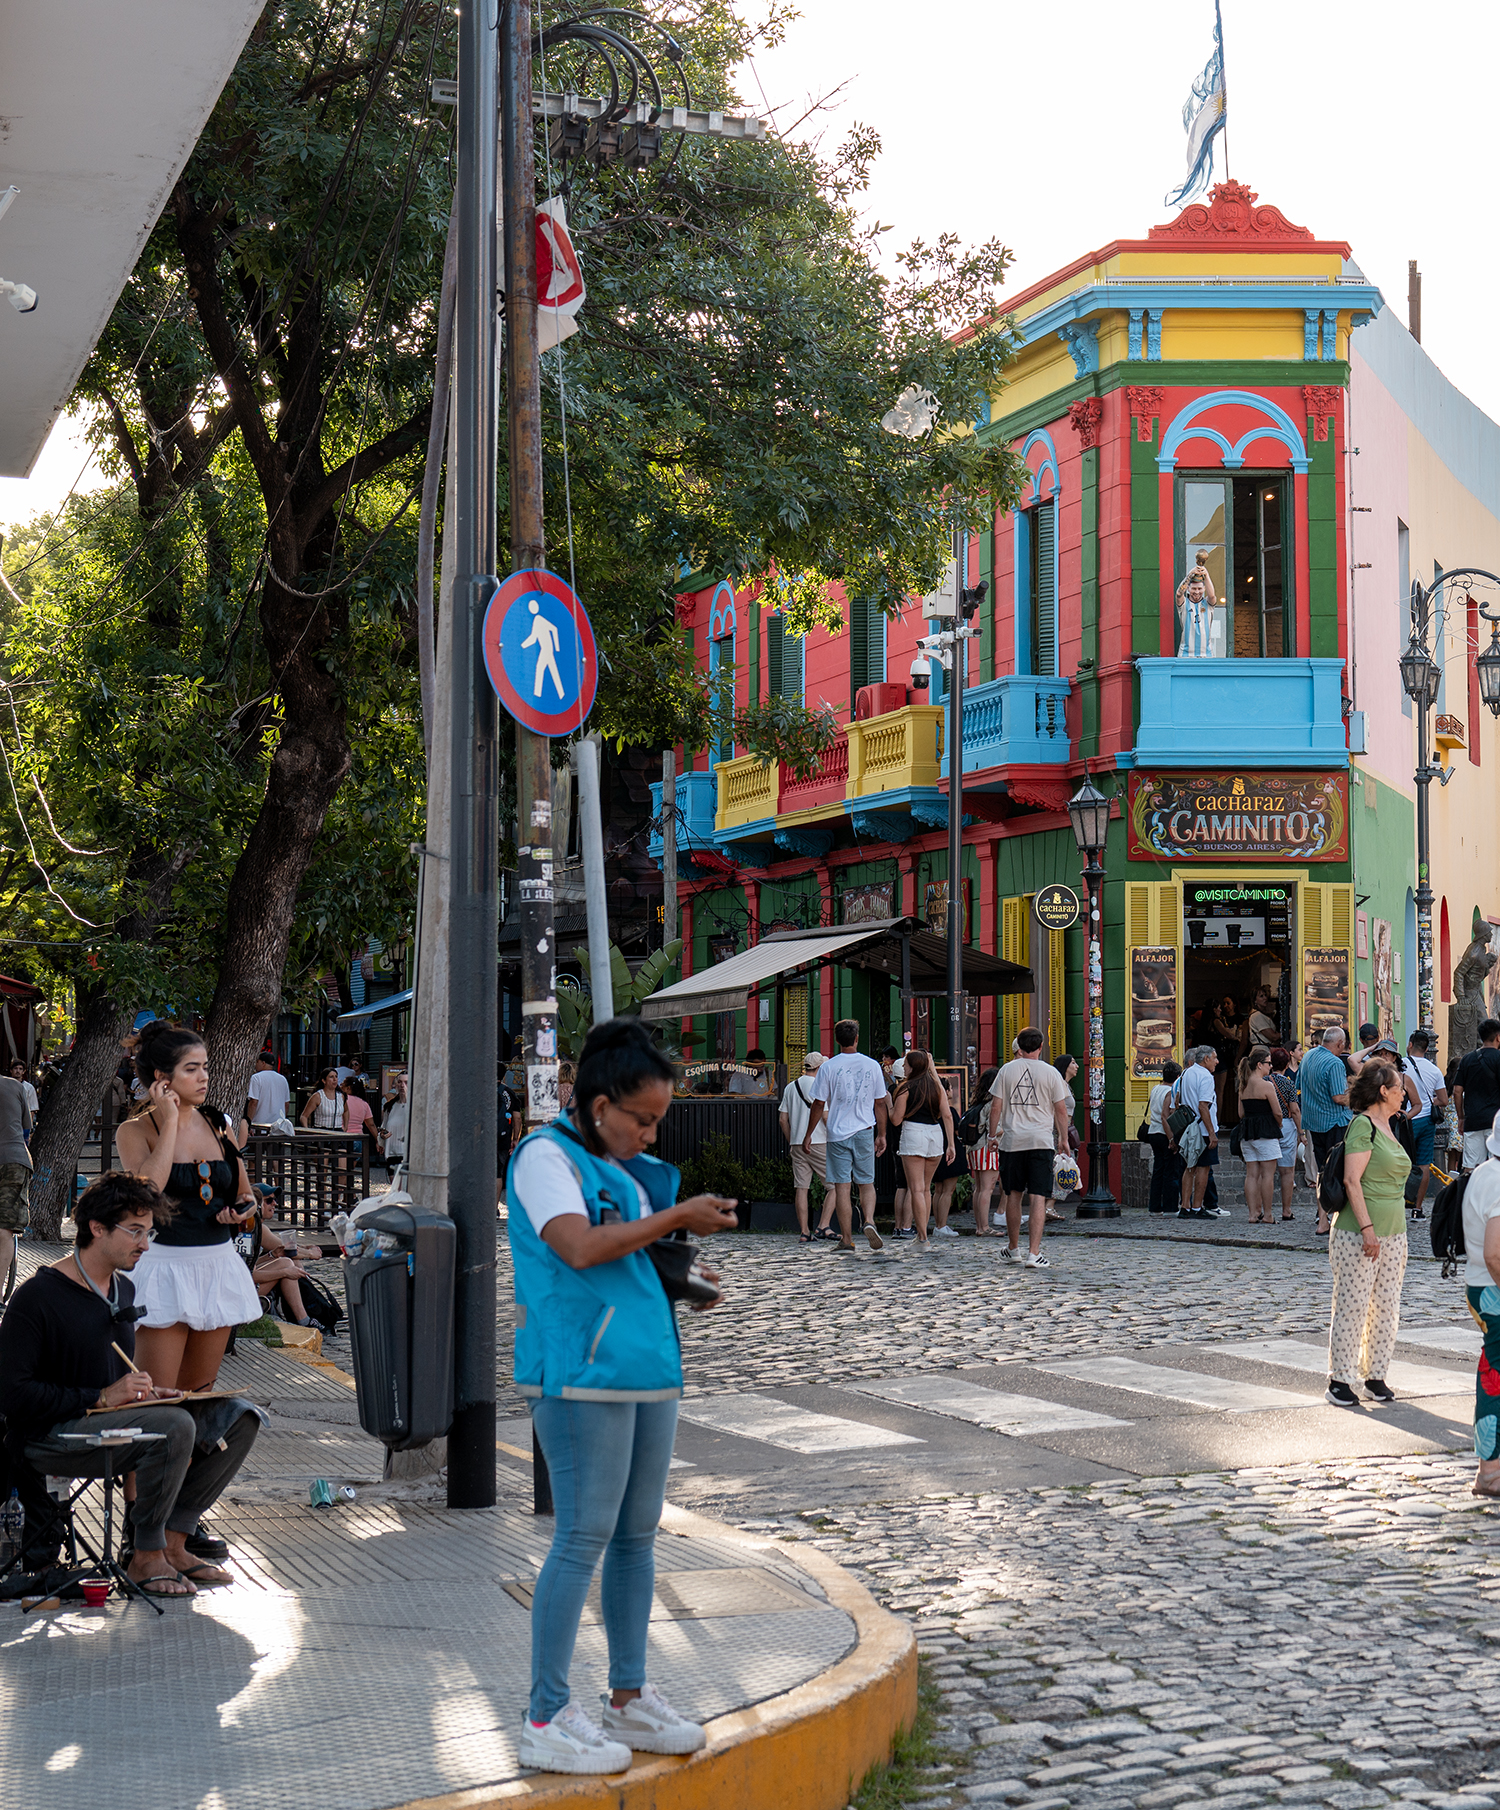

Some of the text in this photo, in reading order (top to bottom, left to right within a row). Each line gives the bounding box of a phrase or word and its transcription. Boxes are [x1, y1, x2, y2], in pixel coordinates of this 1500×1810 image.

[1168, 810, 1311, 843] CAMINITO
[1203, 843, 1276, 851] BUENOS AIRES
[1195, 889, 1286, 902] @VISITCAMINITO
[1135, 954, 1174, 963] ALFAJOR
[1307, 954, 1347, 963] ALFAJOR
[685, 1062, 758, 1077] ESQUINA CAMINITO
